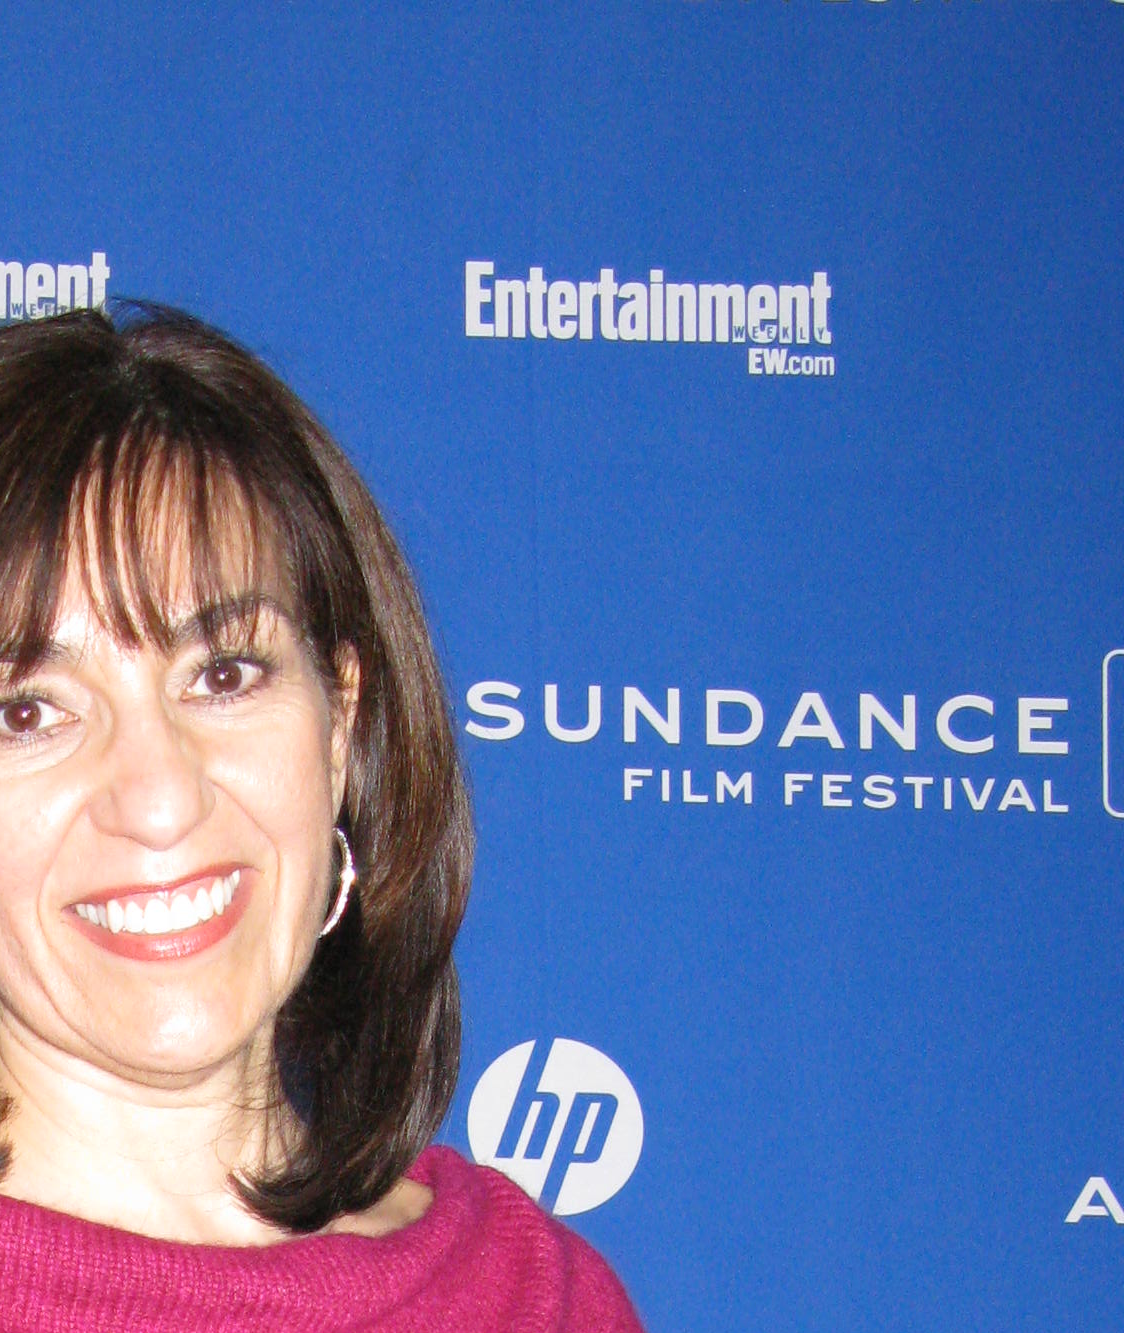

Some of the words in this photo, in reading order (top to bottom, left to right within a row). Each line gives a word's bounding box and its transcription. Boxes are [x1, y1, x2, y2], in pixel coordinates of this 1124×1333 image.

[465, 261, 832, 344] Entertainment
[734, 325, 826, 341] WEEKLY
[748, 348, 836, 375] EW.com
[465, 681, 1069, 755] SUNDANCE
[623, 768, 753, 804] FILM
[784, 773, 1069, 813] FESTIVAL
[495, 1038, 618, 1214] hp
